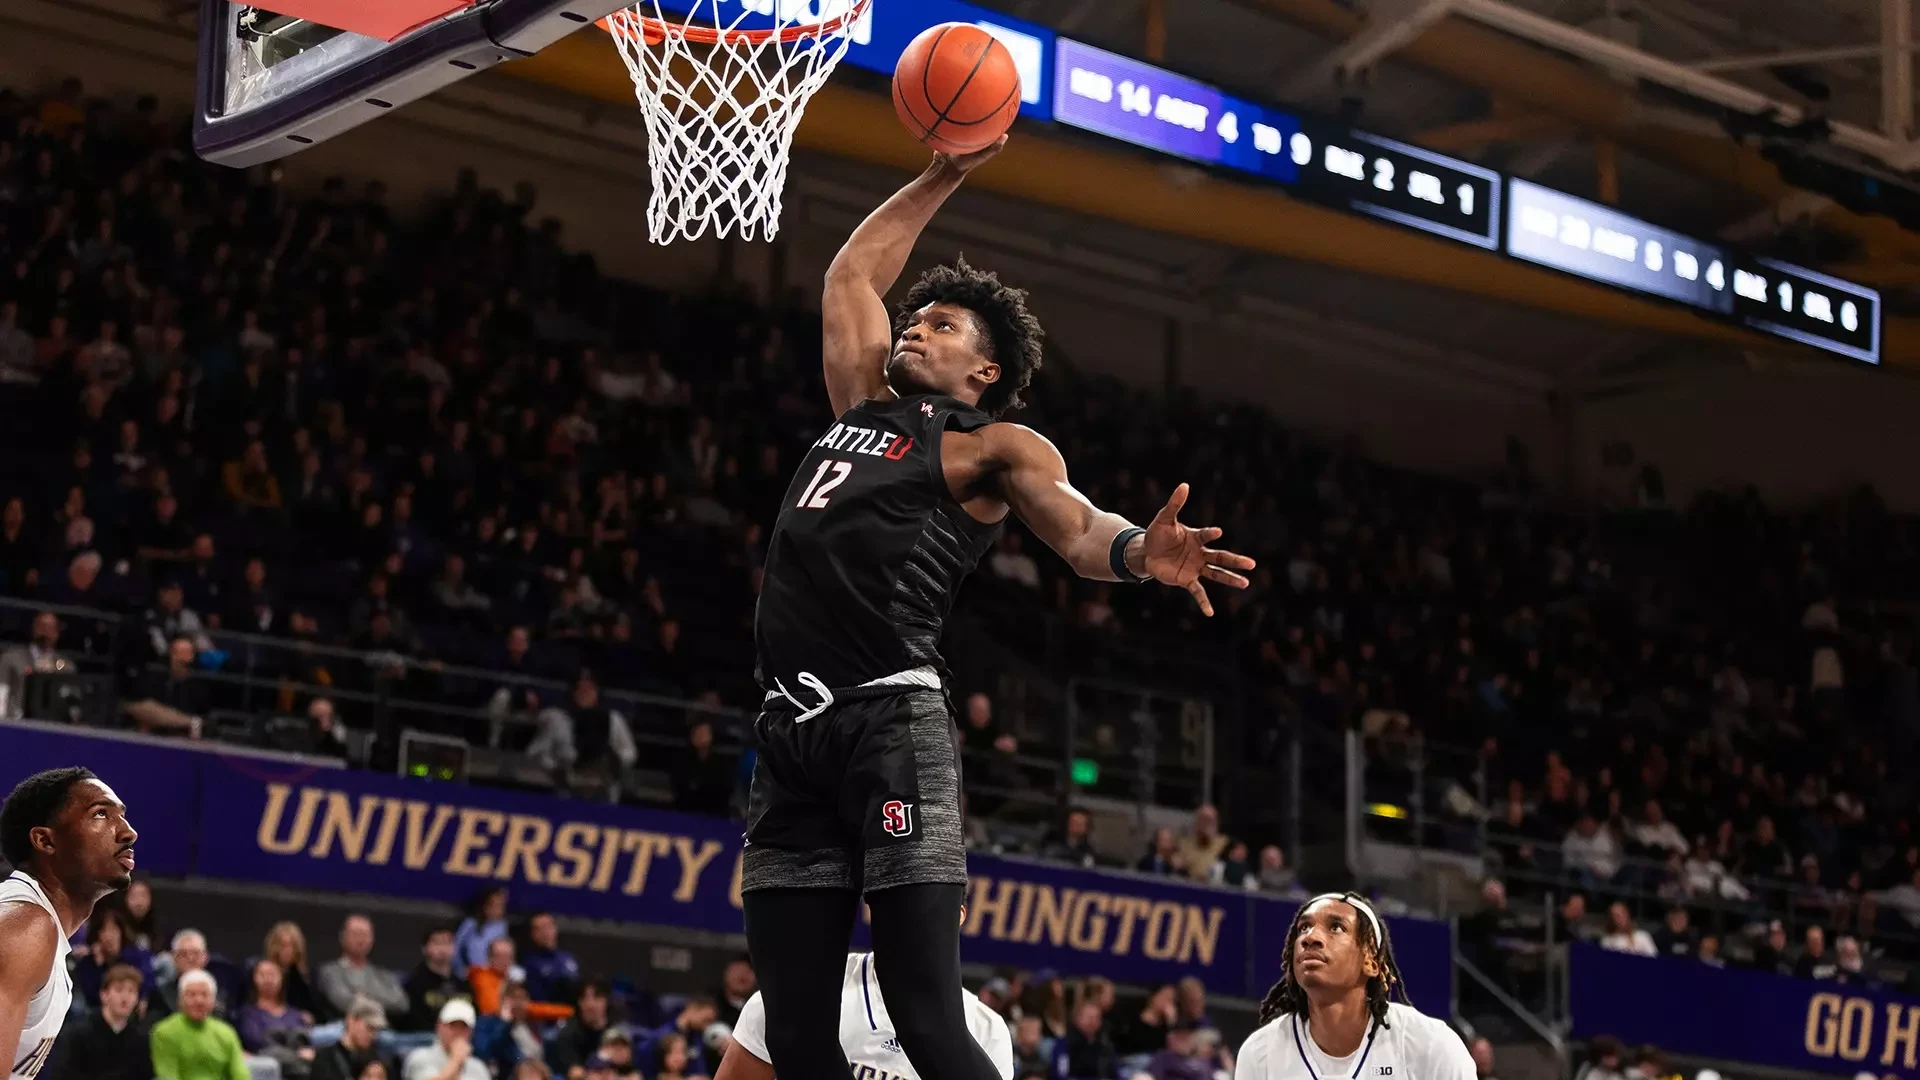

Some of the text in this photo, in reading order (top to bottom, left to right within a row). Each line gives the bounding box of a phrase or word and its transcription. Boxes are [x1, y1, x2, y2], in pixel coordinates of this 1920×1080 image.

[1117, 80, 1152, 117] 14
[1216, 111, 1239, 144] 4
[1290, 132, 1312, 166] 9
[1373, 157, 1395, 192] 2
[1456, 182, 1475, 215] 1
[1705, 259, 1725, 291] 4
[1777, 280, 1793, 313] 1
[1840, 300, 1858, 332] 6
[812, 422, 914, 461] ATTLEU
[796, 459, 853, 509] 12
[256, 783, 723, 904] UNIVERSITY
[881, 1042, 901, 1054] adidas
[1804, 991, 1920, 1070] GO H
